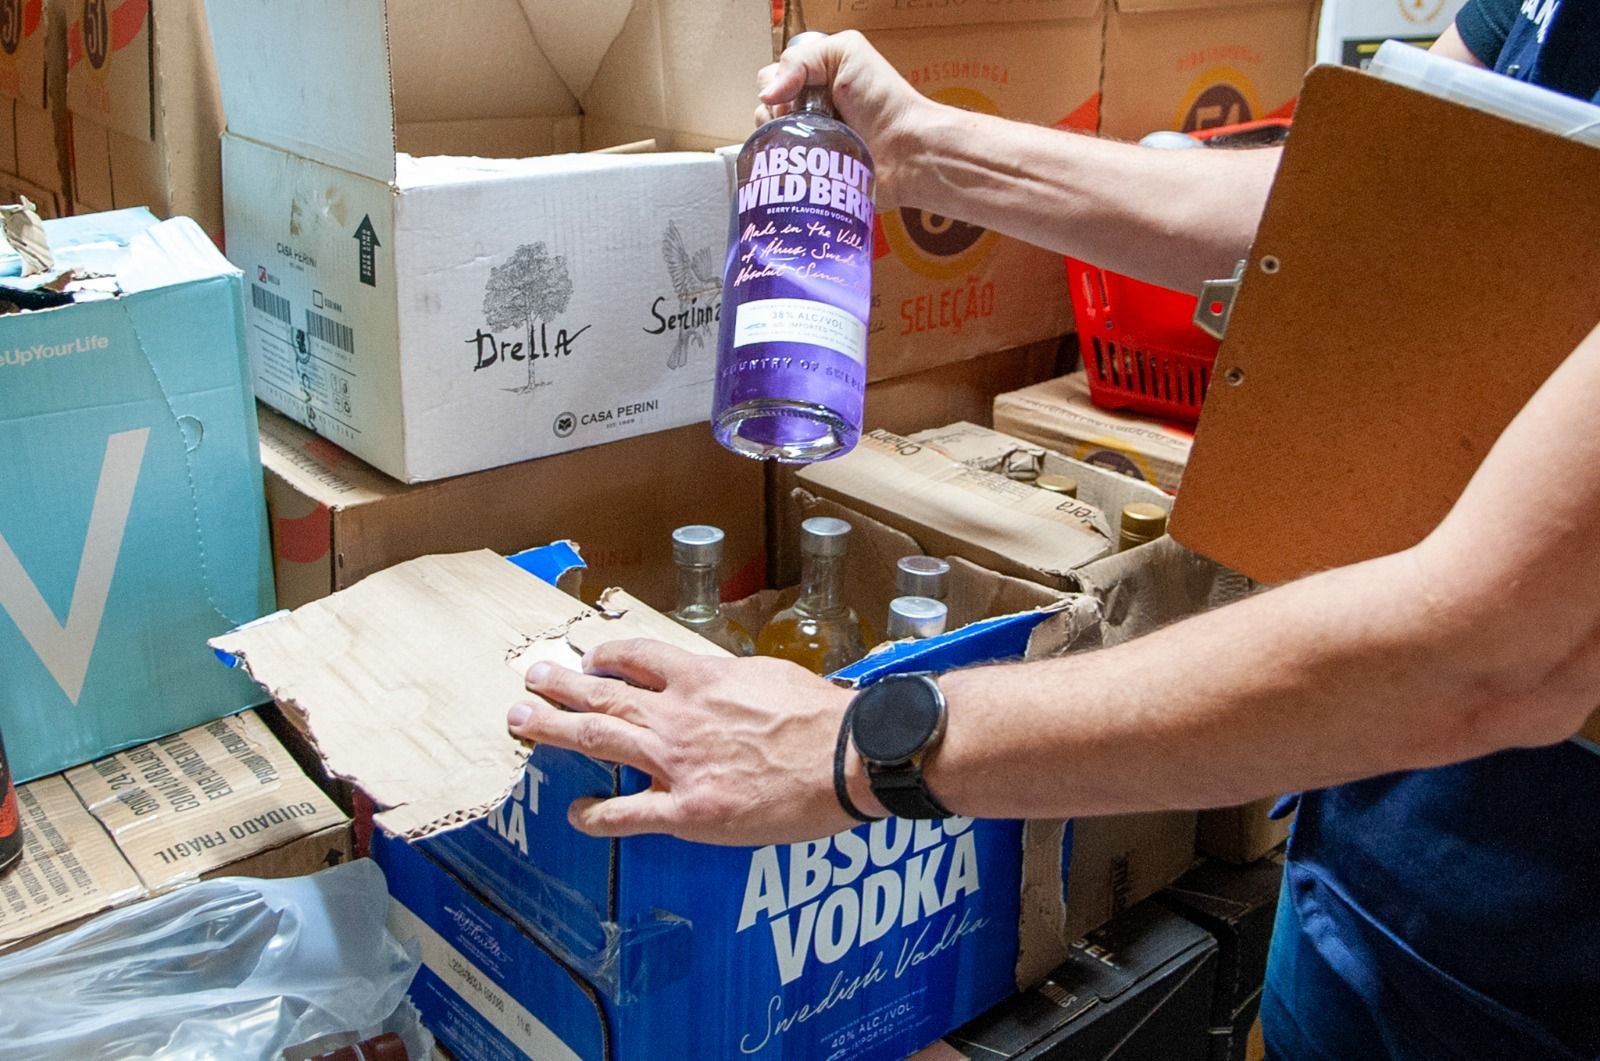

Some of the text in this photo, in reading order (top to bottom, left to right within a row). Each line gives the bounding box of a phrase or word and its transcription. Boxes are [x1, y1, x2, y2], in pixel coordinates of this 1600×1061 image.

[902, 57, 1010, 87] RASSUNUNGA
[749, 145, 873, 194] ABSOLUT
[738, 174, 806, 215] WILD
[767, 205, 853, 224] BERRY FLAVORED VODKA
[740, 221, 776, 243] Made
[780, 224, 802, 234] in
[807, 221, 832, 238] the
[741, 245, 756, 263] of
[733, 263, 793, 287] Absolut
[900, 274, 995, 337] SELEÇÃO
[581, 400, 659, 426] CASA PERINI
[105, 772, 136, 791] 24
[153, 801, 318, 865] CUIDADO FRÁGIL
[736, 816, 976, 933] ABSOL
[770, 830, 981, 987] VODKA
[740, 950, 888, 1054] Swedish
[894, 907, 989, 979] Vodka
[832, 1030, 855, 1048] 40%
